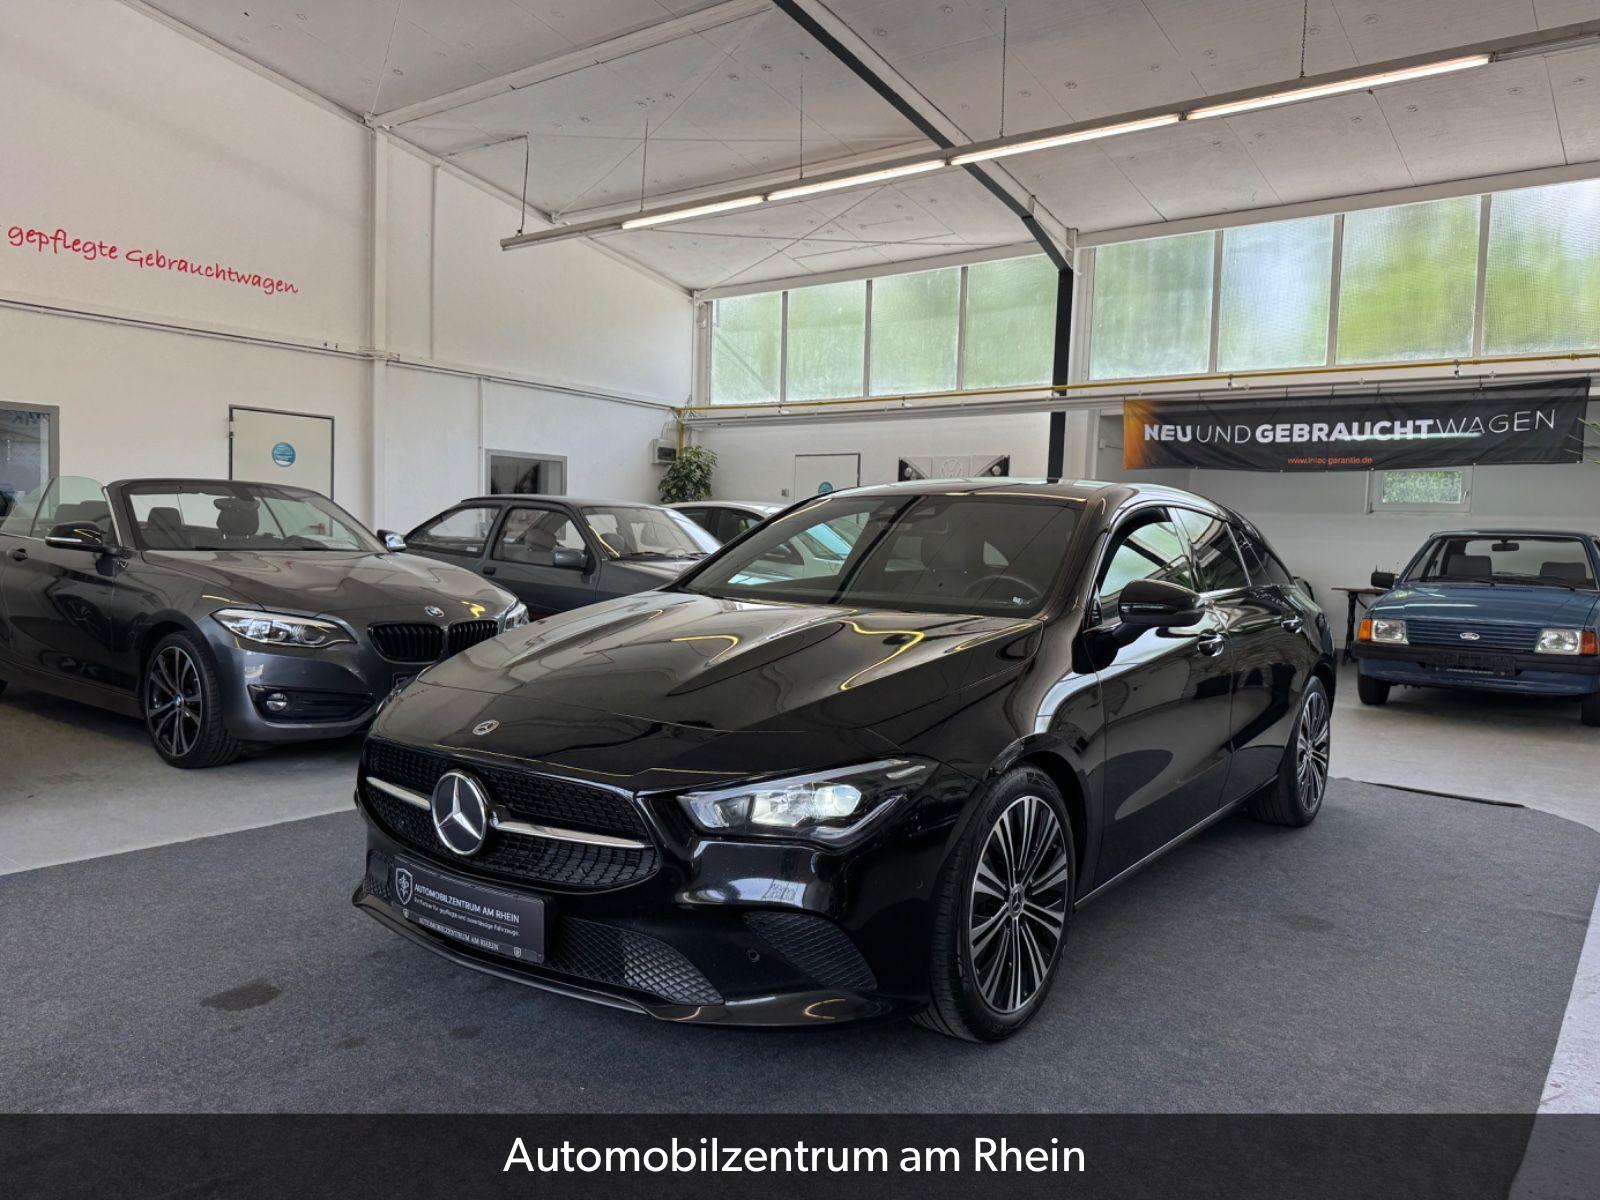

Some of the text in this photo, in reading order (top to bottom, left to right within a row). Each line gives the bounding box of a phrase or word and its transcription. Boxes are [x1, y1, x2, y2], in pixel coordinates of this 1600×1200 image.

[7, 226, 299, 295] gepflegte Gebrauchtwagen
[414, 883, 520, 923] AUTOMOBILZENTRUM AM RHEIN
